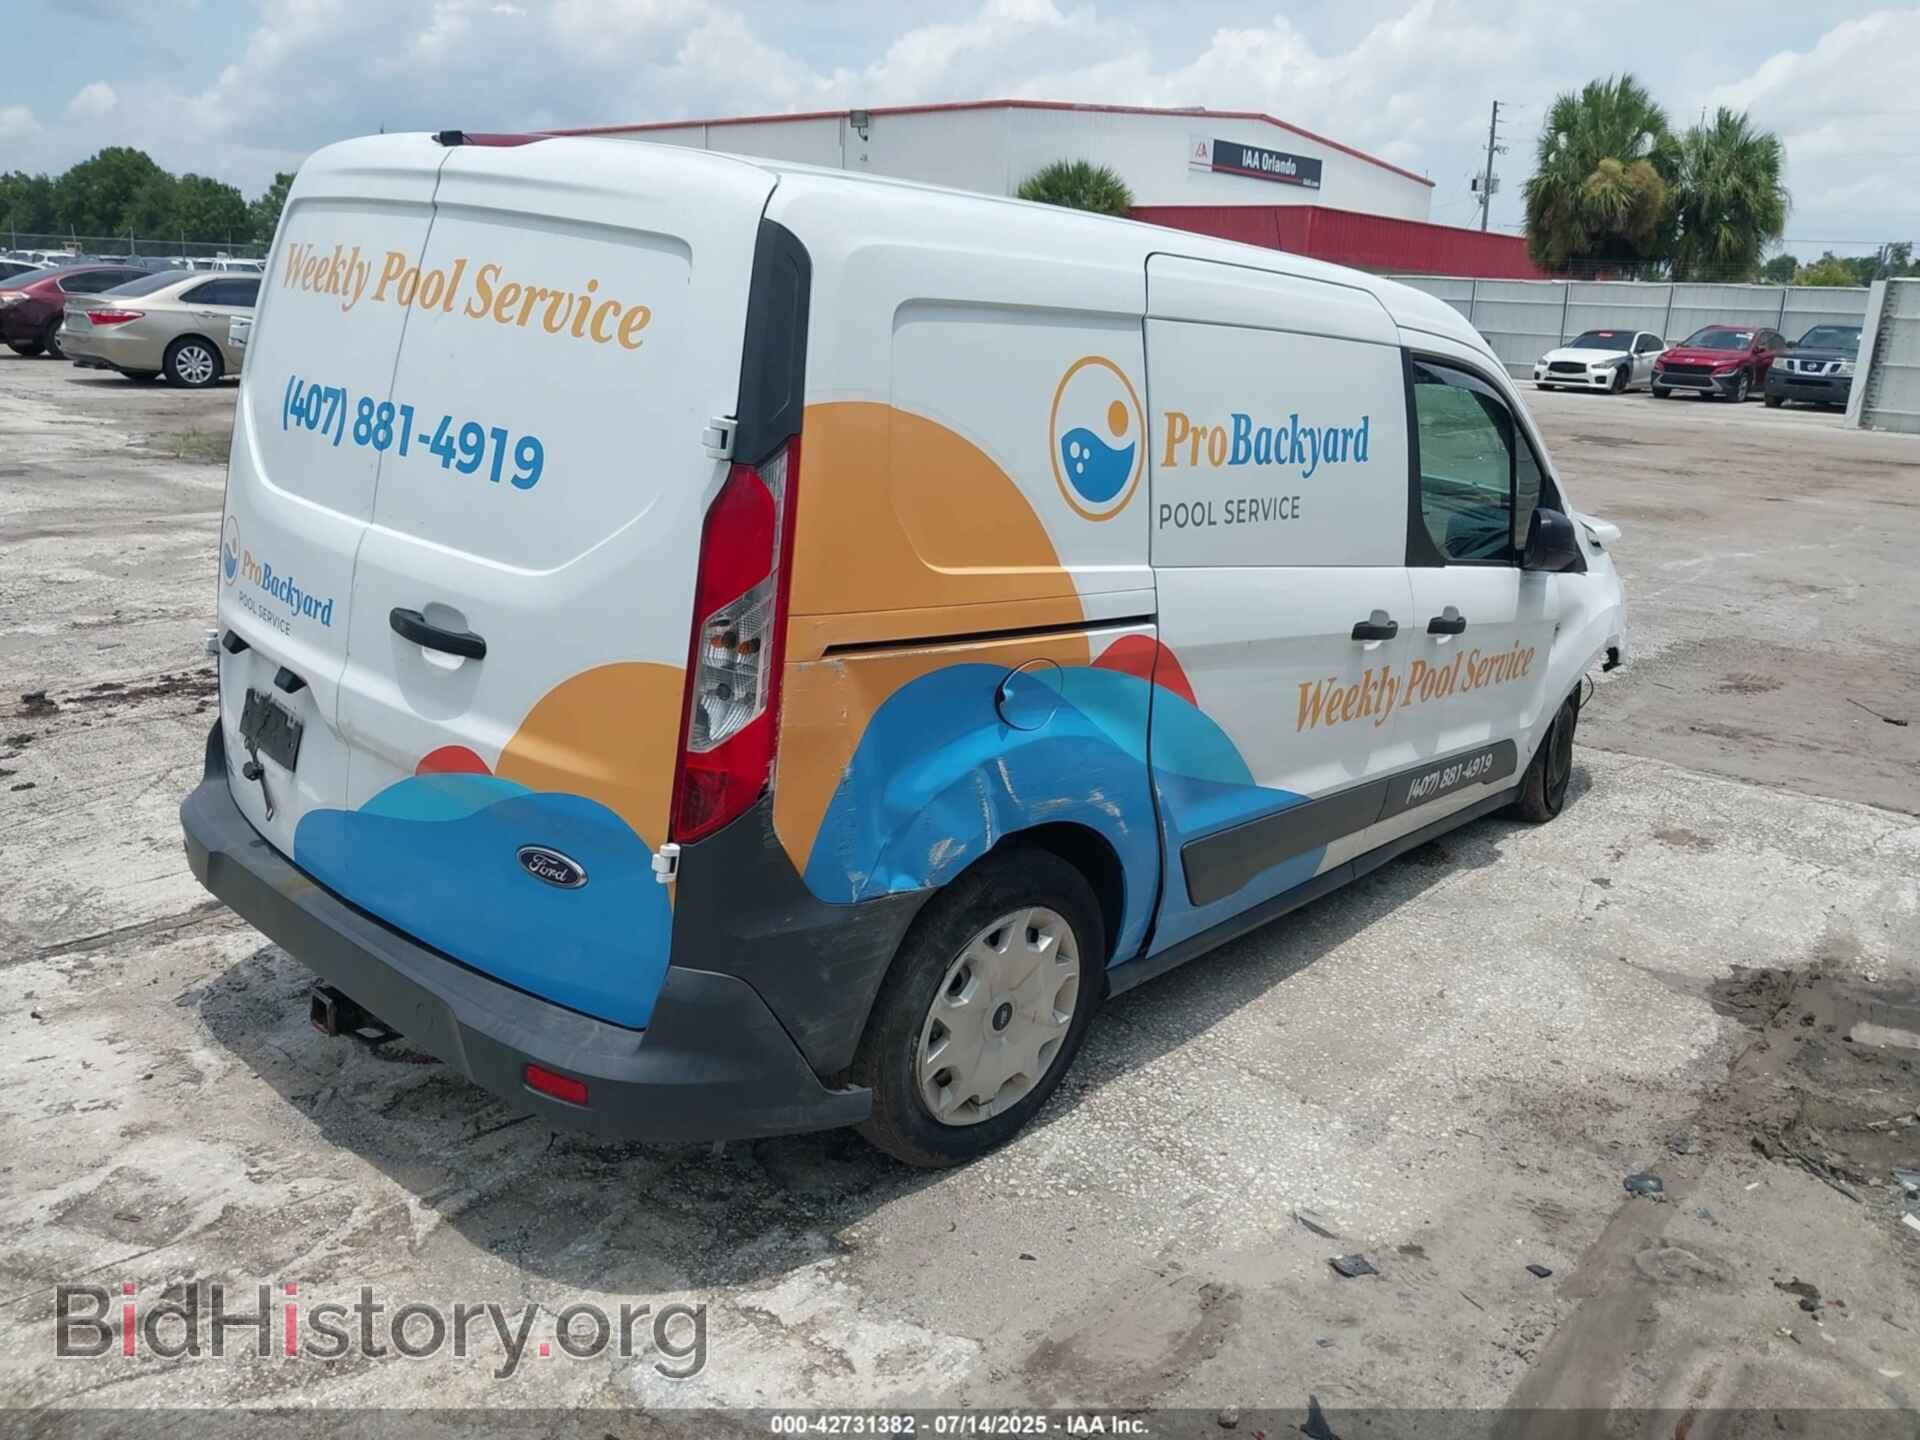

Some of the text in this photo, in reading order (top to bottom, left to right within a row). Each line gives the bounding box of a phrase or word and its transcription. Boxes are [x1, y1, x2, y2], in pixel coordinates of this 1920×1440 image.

[1242, 149, 1297, 175] IAA Orlando
[283, 242, 652, 350] Weekly Pool Service
[282, 375, 545, 490] (407) 881-4919
[1161, 411, 1369, 479] ProBackyard
[1159, 496, 1300, 530] POOL SERVICE
[241, 550, 334, 627] ProBackyard
[257, 604, 291, 636] SERVICE
[1296, 640, 1535, 732] Weekly Pool Service
[1406, 753, 1493, 804] (407) 881-4919
[528, 854, 569, 882] Ford
